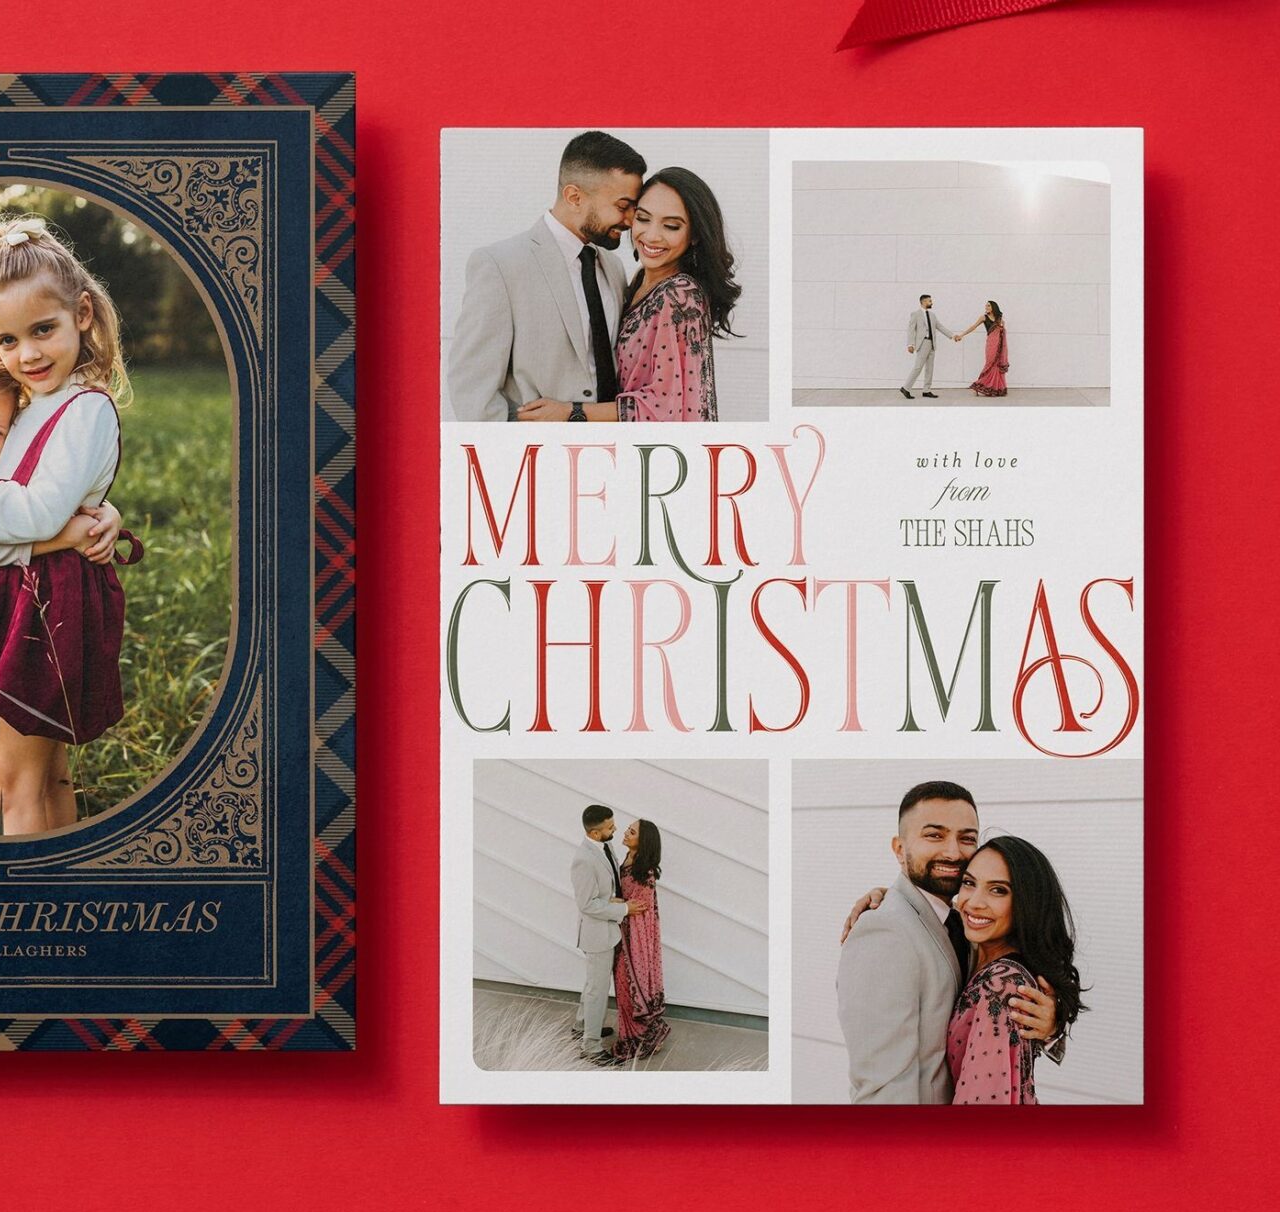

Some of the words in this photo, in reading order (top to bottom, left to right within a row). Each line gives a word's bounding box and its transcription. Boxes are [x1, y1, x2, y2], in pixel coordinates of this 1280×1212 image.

[916, 451, 962, 469] with
[974, 451, 1019, 469] love
[460, 424, 827, 583] MERRY
[929, 476, 992, 511] from
[899, 518, 947, 547] THE
[953, 518, 1036, 547] SHAHS
[446, 576, 1140, 758] CHRISTMAS
